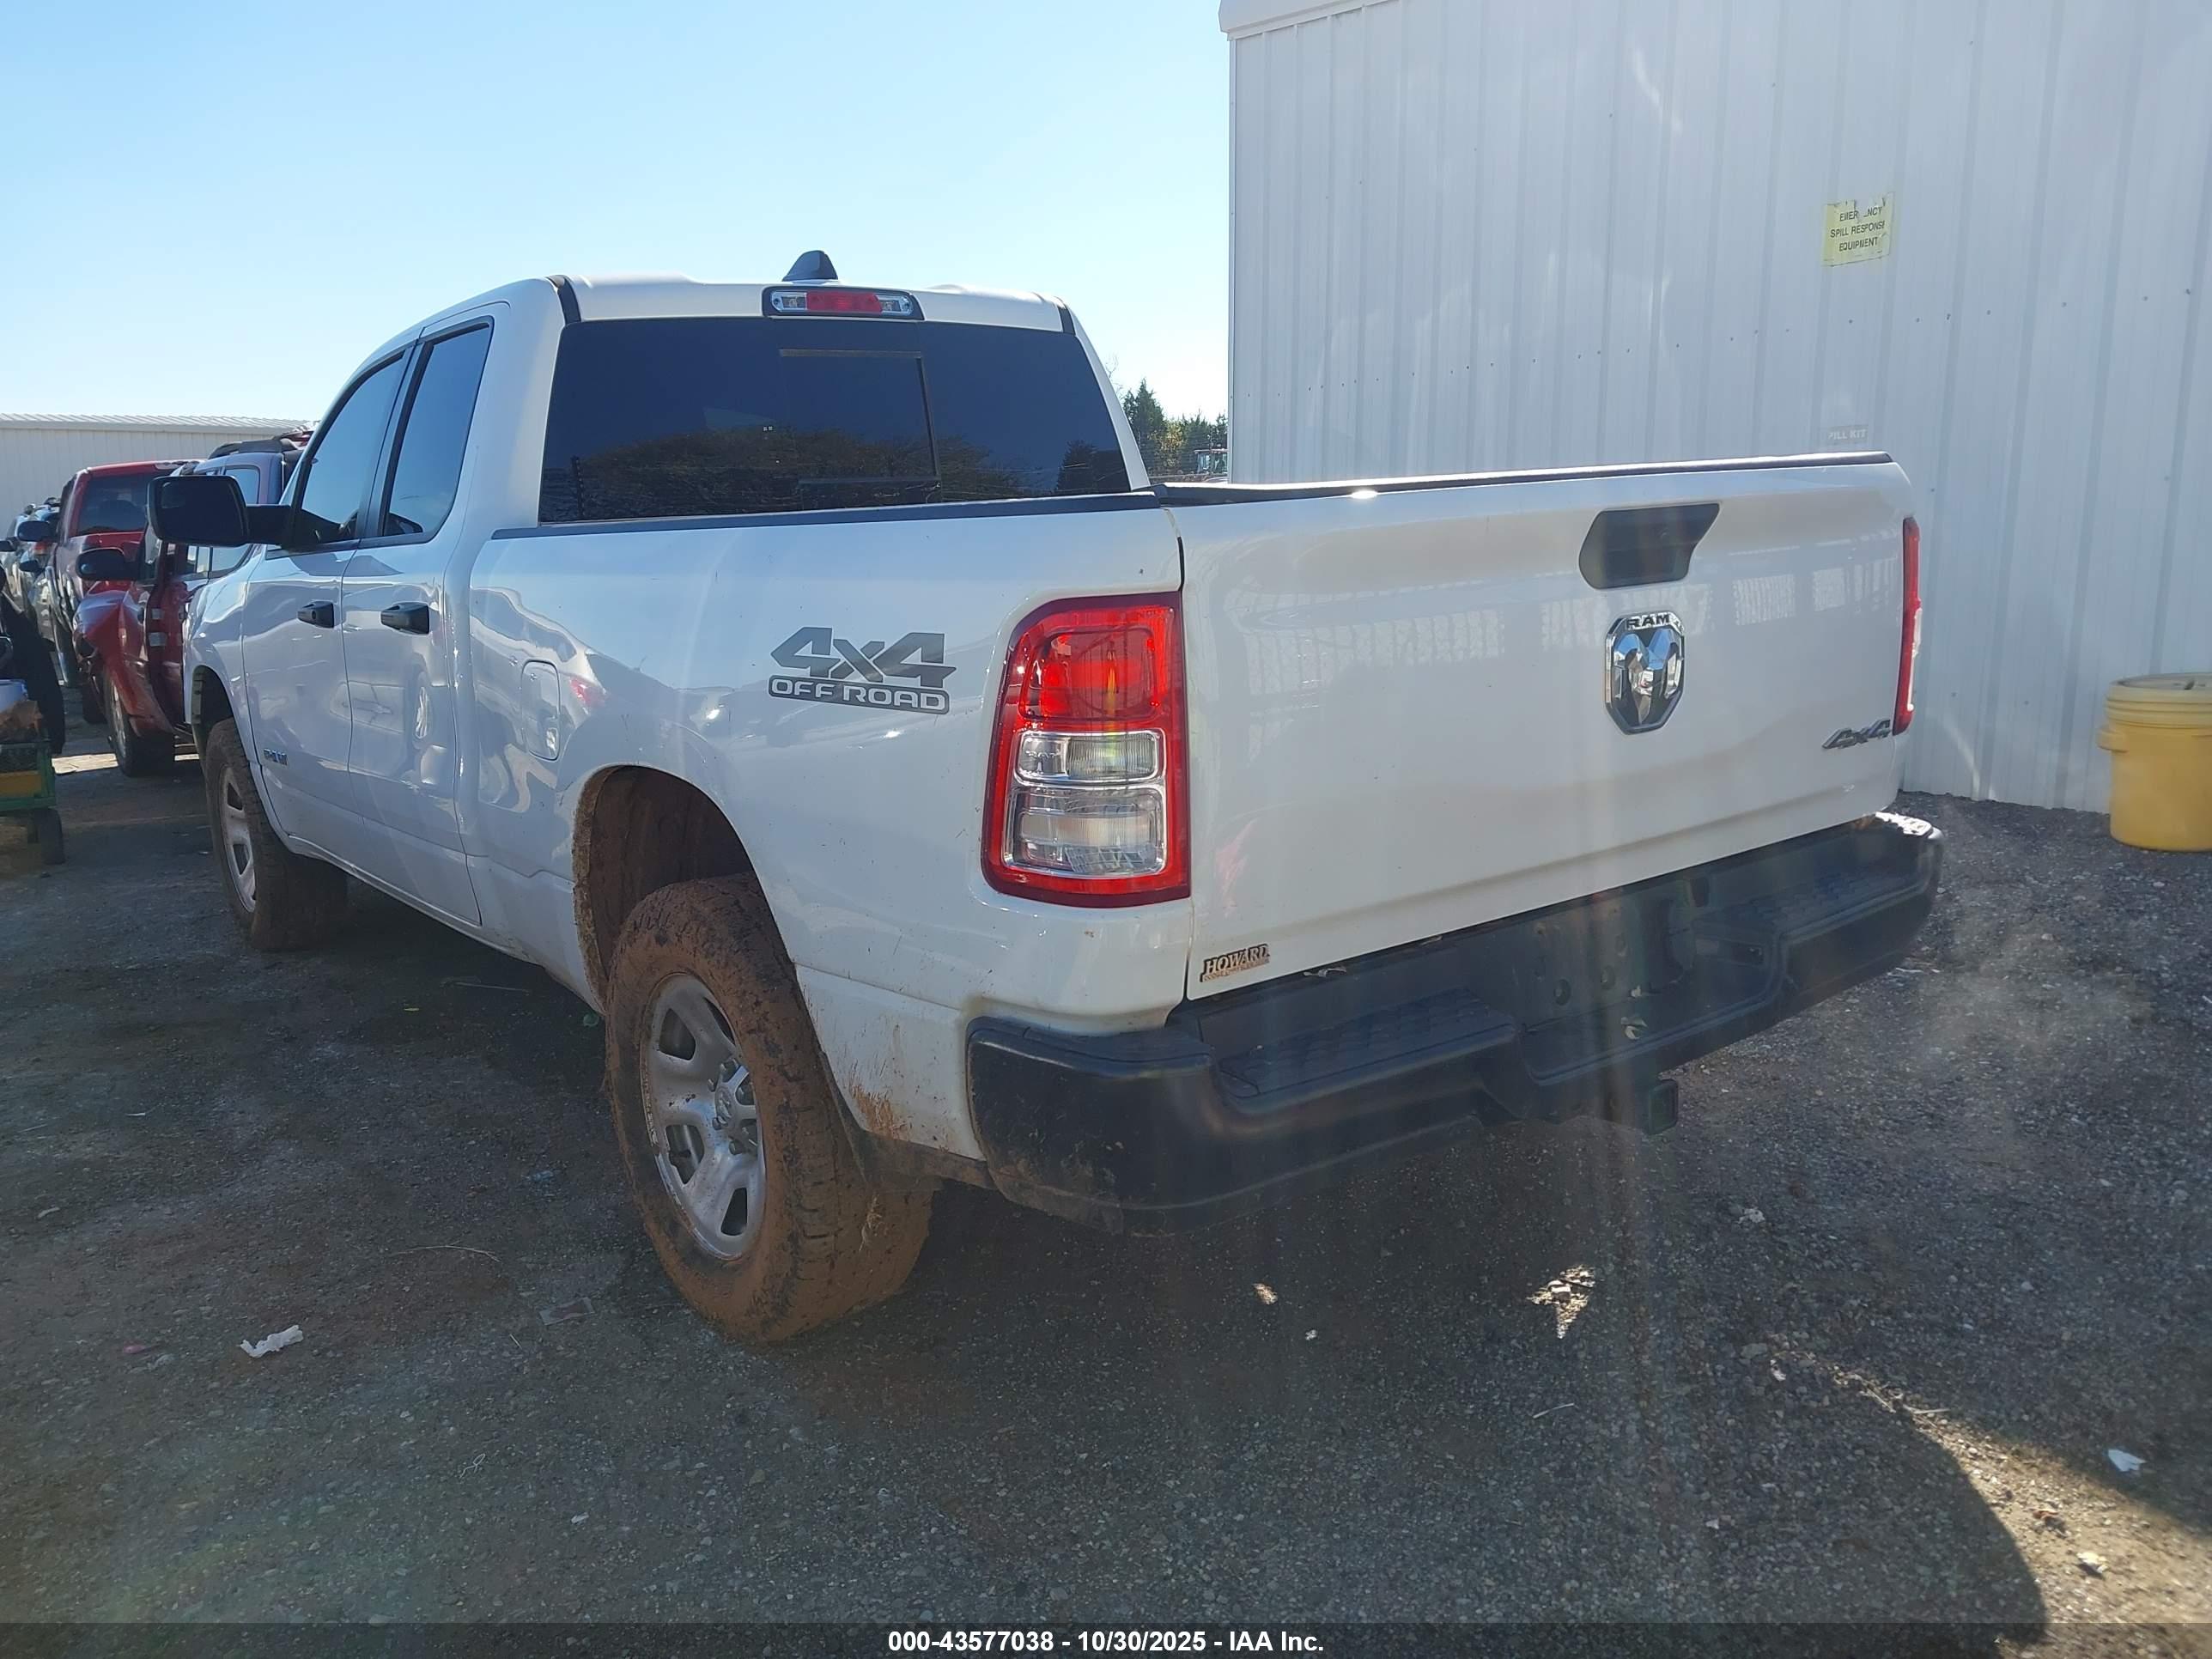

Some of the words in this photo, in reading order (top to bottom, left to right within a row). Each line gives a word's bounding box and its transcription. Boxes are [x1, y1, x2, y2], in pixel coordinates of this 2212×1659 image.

[1839, 207, 1883, 222] EMERNCY
[1830, 227, 1850, 239] SPILL
[1839, 237, 1878, 252] EQUIPMENT
[1850, 428, 1867, 439] KIT
[1626, 613, 1670, 629] RAM
[772, 678, 836, 698] OFF
[843, 685, 945, 710] ROAD
